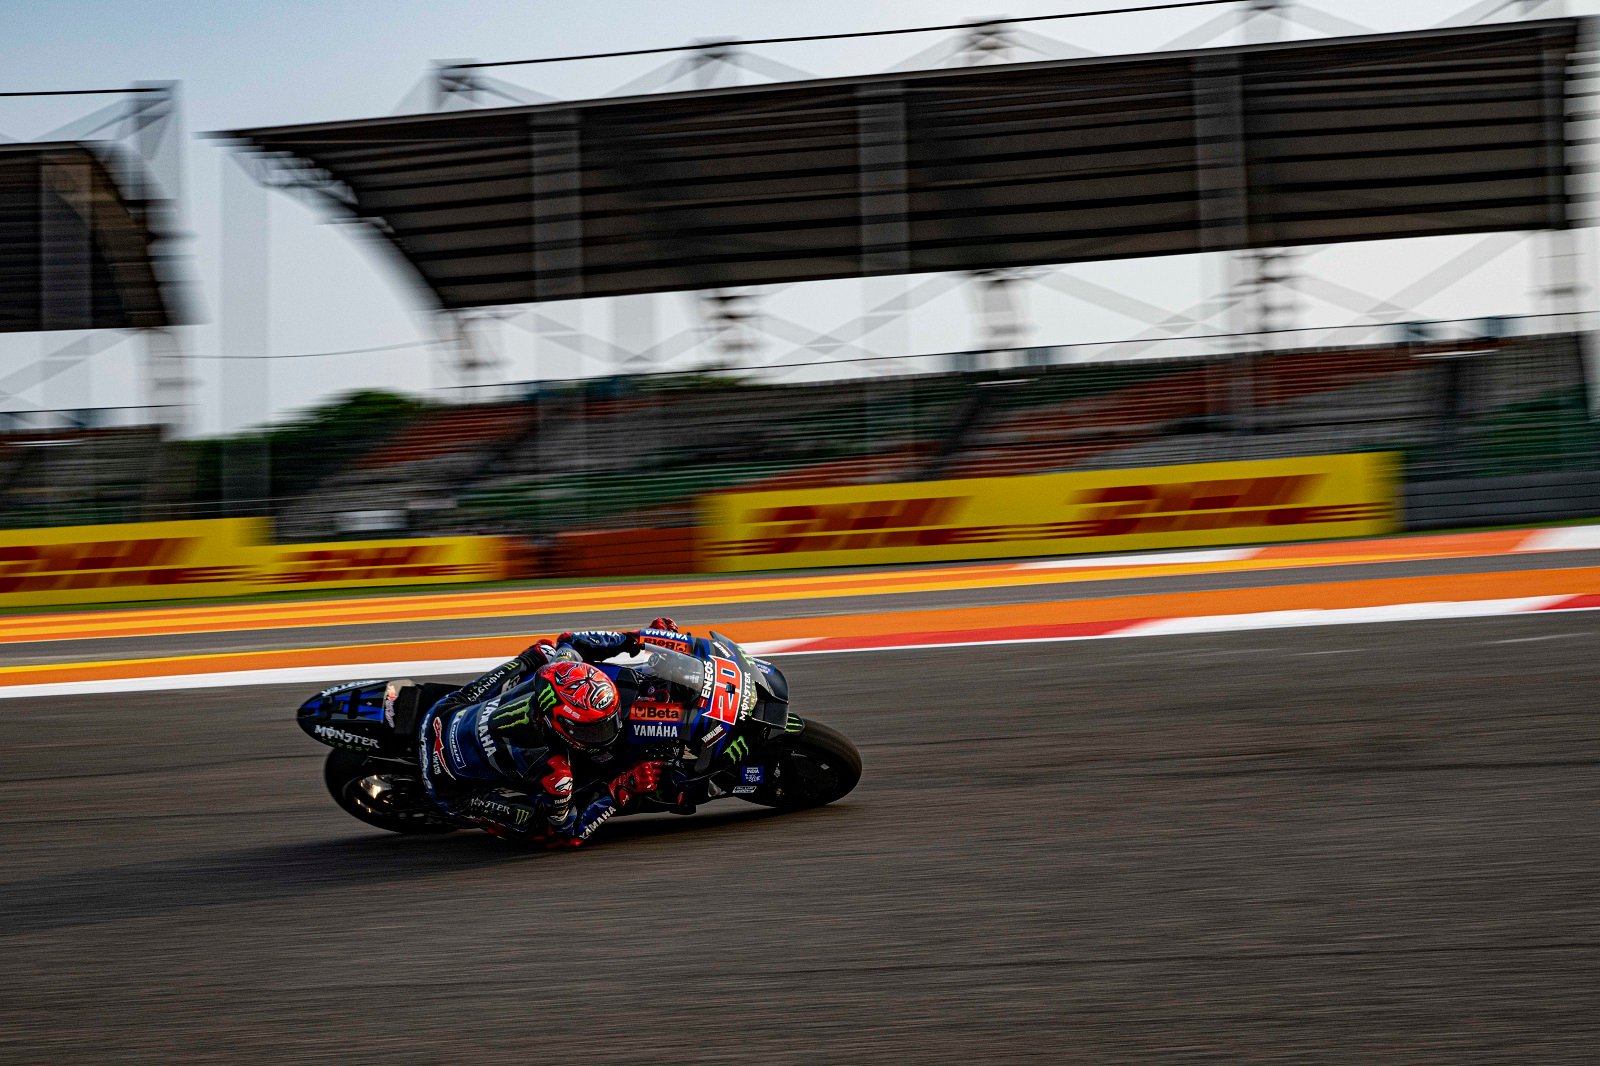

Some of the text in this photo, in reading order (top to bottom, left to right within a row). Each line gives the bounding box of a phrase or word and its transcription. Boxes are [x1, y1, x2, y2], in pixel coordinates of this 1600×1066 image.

[645, 630, 688, 641] YAMAHA
[701, 661, 714, 699] ENEOS
[701, 654, 743, 726] 20
[739, 671, 752, 721] MONSTER
[478, 698, 501, 757] YAMAHA
[647, 707, 679, 718] Beta
[314, 724, 380, 749] MONSTER
[633, 725, 678, 738] YAMAHA
[579, 805, 617, 839] YAMAHA
